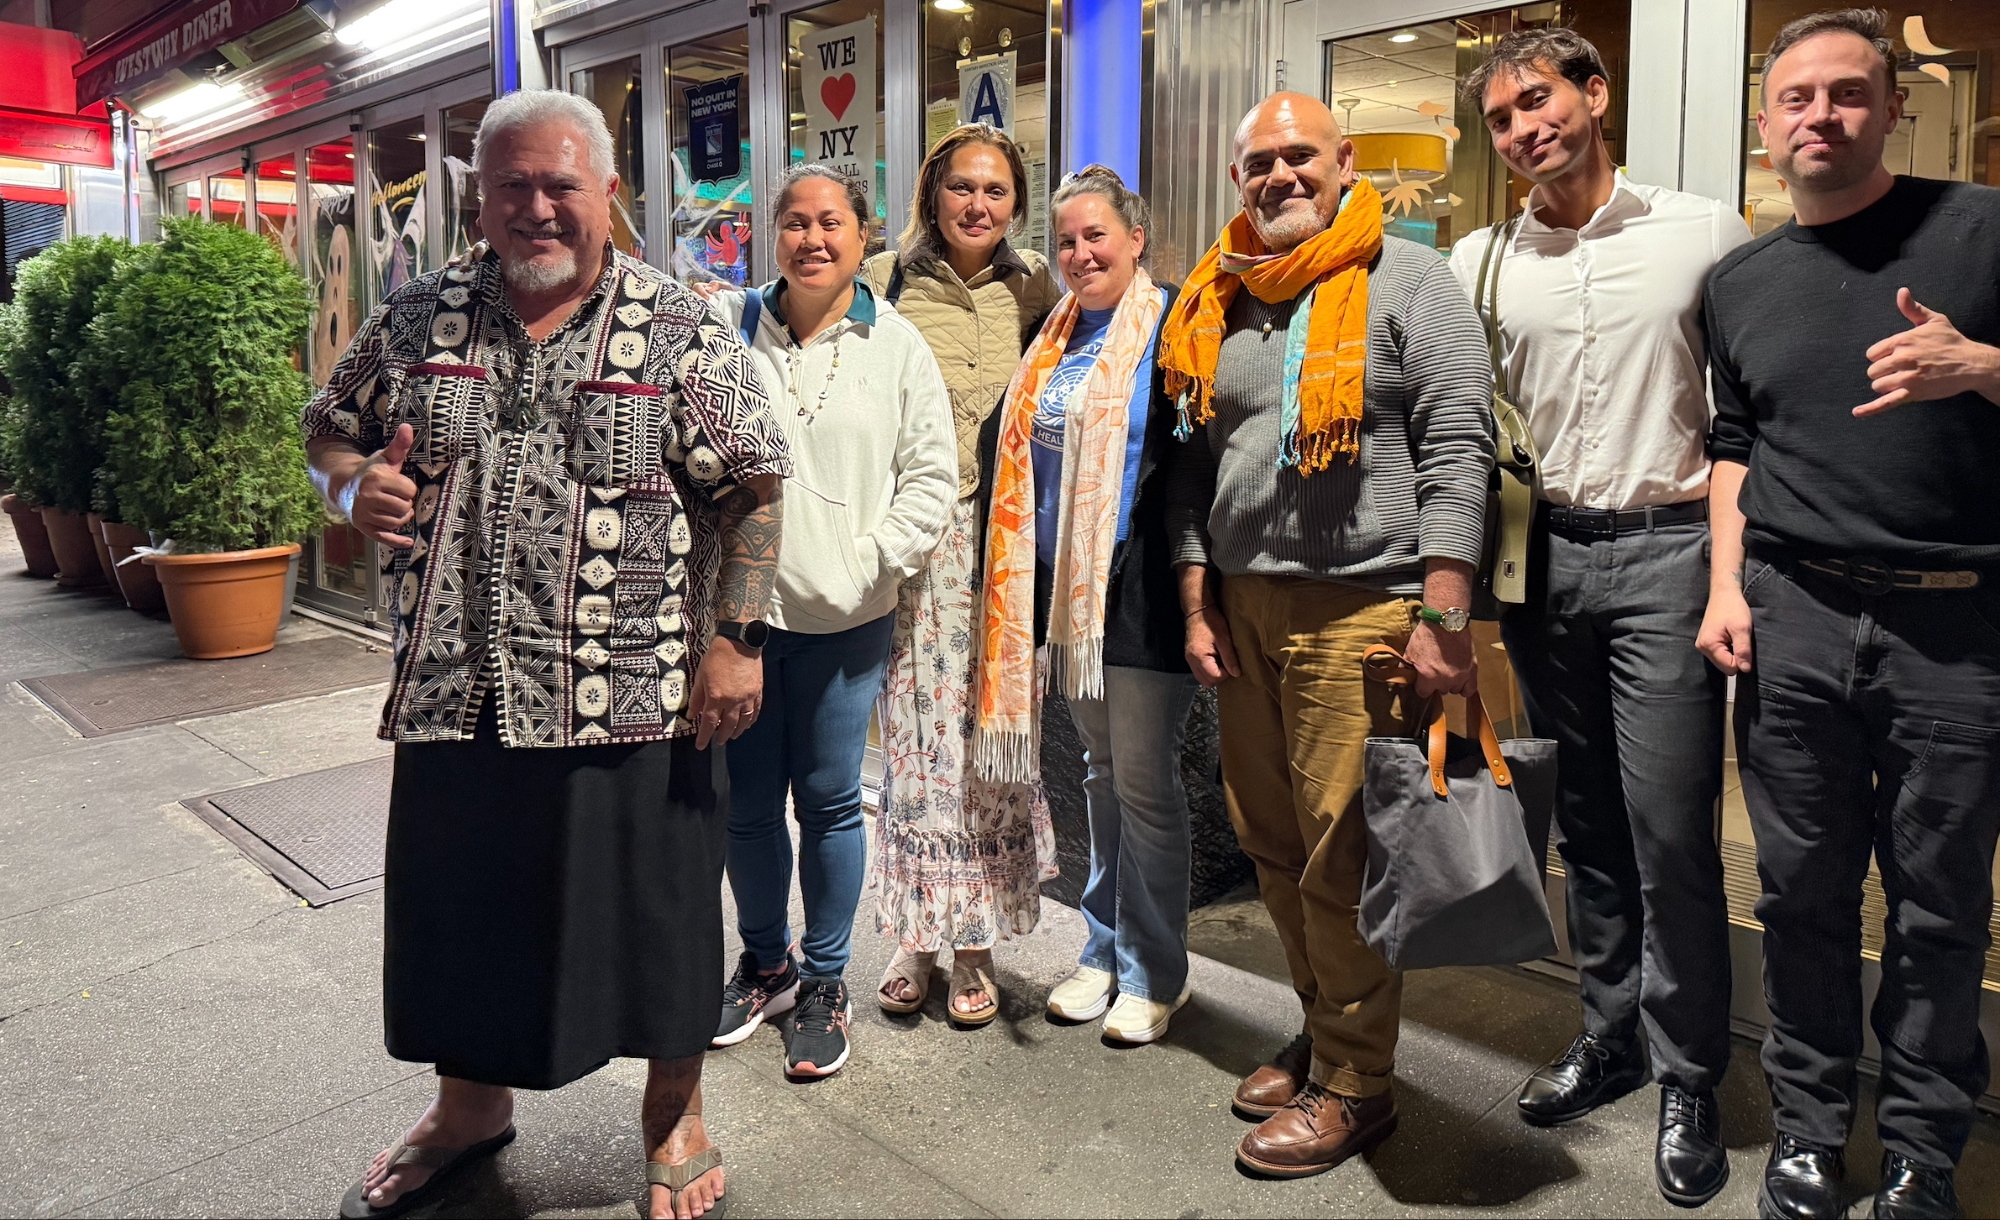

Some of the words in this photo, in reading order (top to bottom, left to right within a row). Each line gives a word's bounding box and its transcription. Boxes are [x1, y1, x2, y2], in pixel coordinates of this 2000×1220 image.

[114, 28, 179, 84] WESTWAY
[182, 0, 233, 52] DINER
[817, 35, 856, 71] WE
[691, 97, 704, 108] NO
[705, 92, 725, 105] QUIT
[726, 89, 736, 98] IN
[691, 106, 711, 118] NEW
[712, 100, 737, 113] YORK
[970, 72, 1004, 128] A
[819, 125, 859, 160] NY
[371, 170, 427, 208] Halloween
